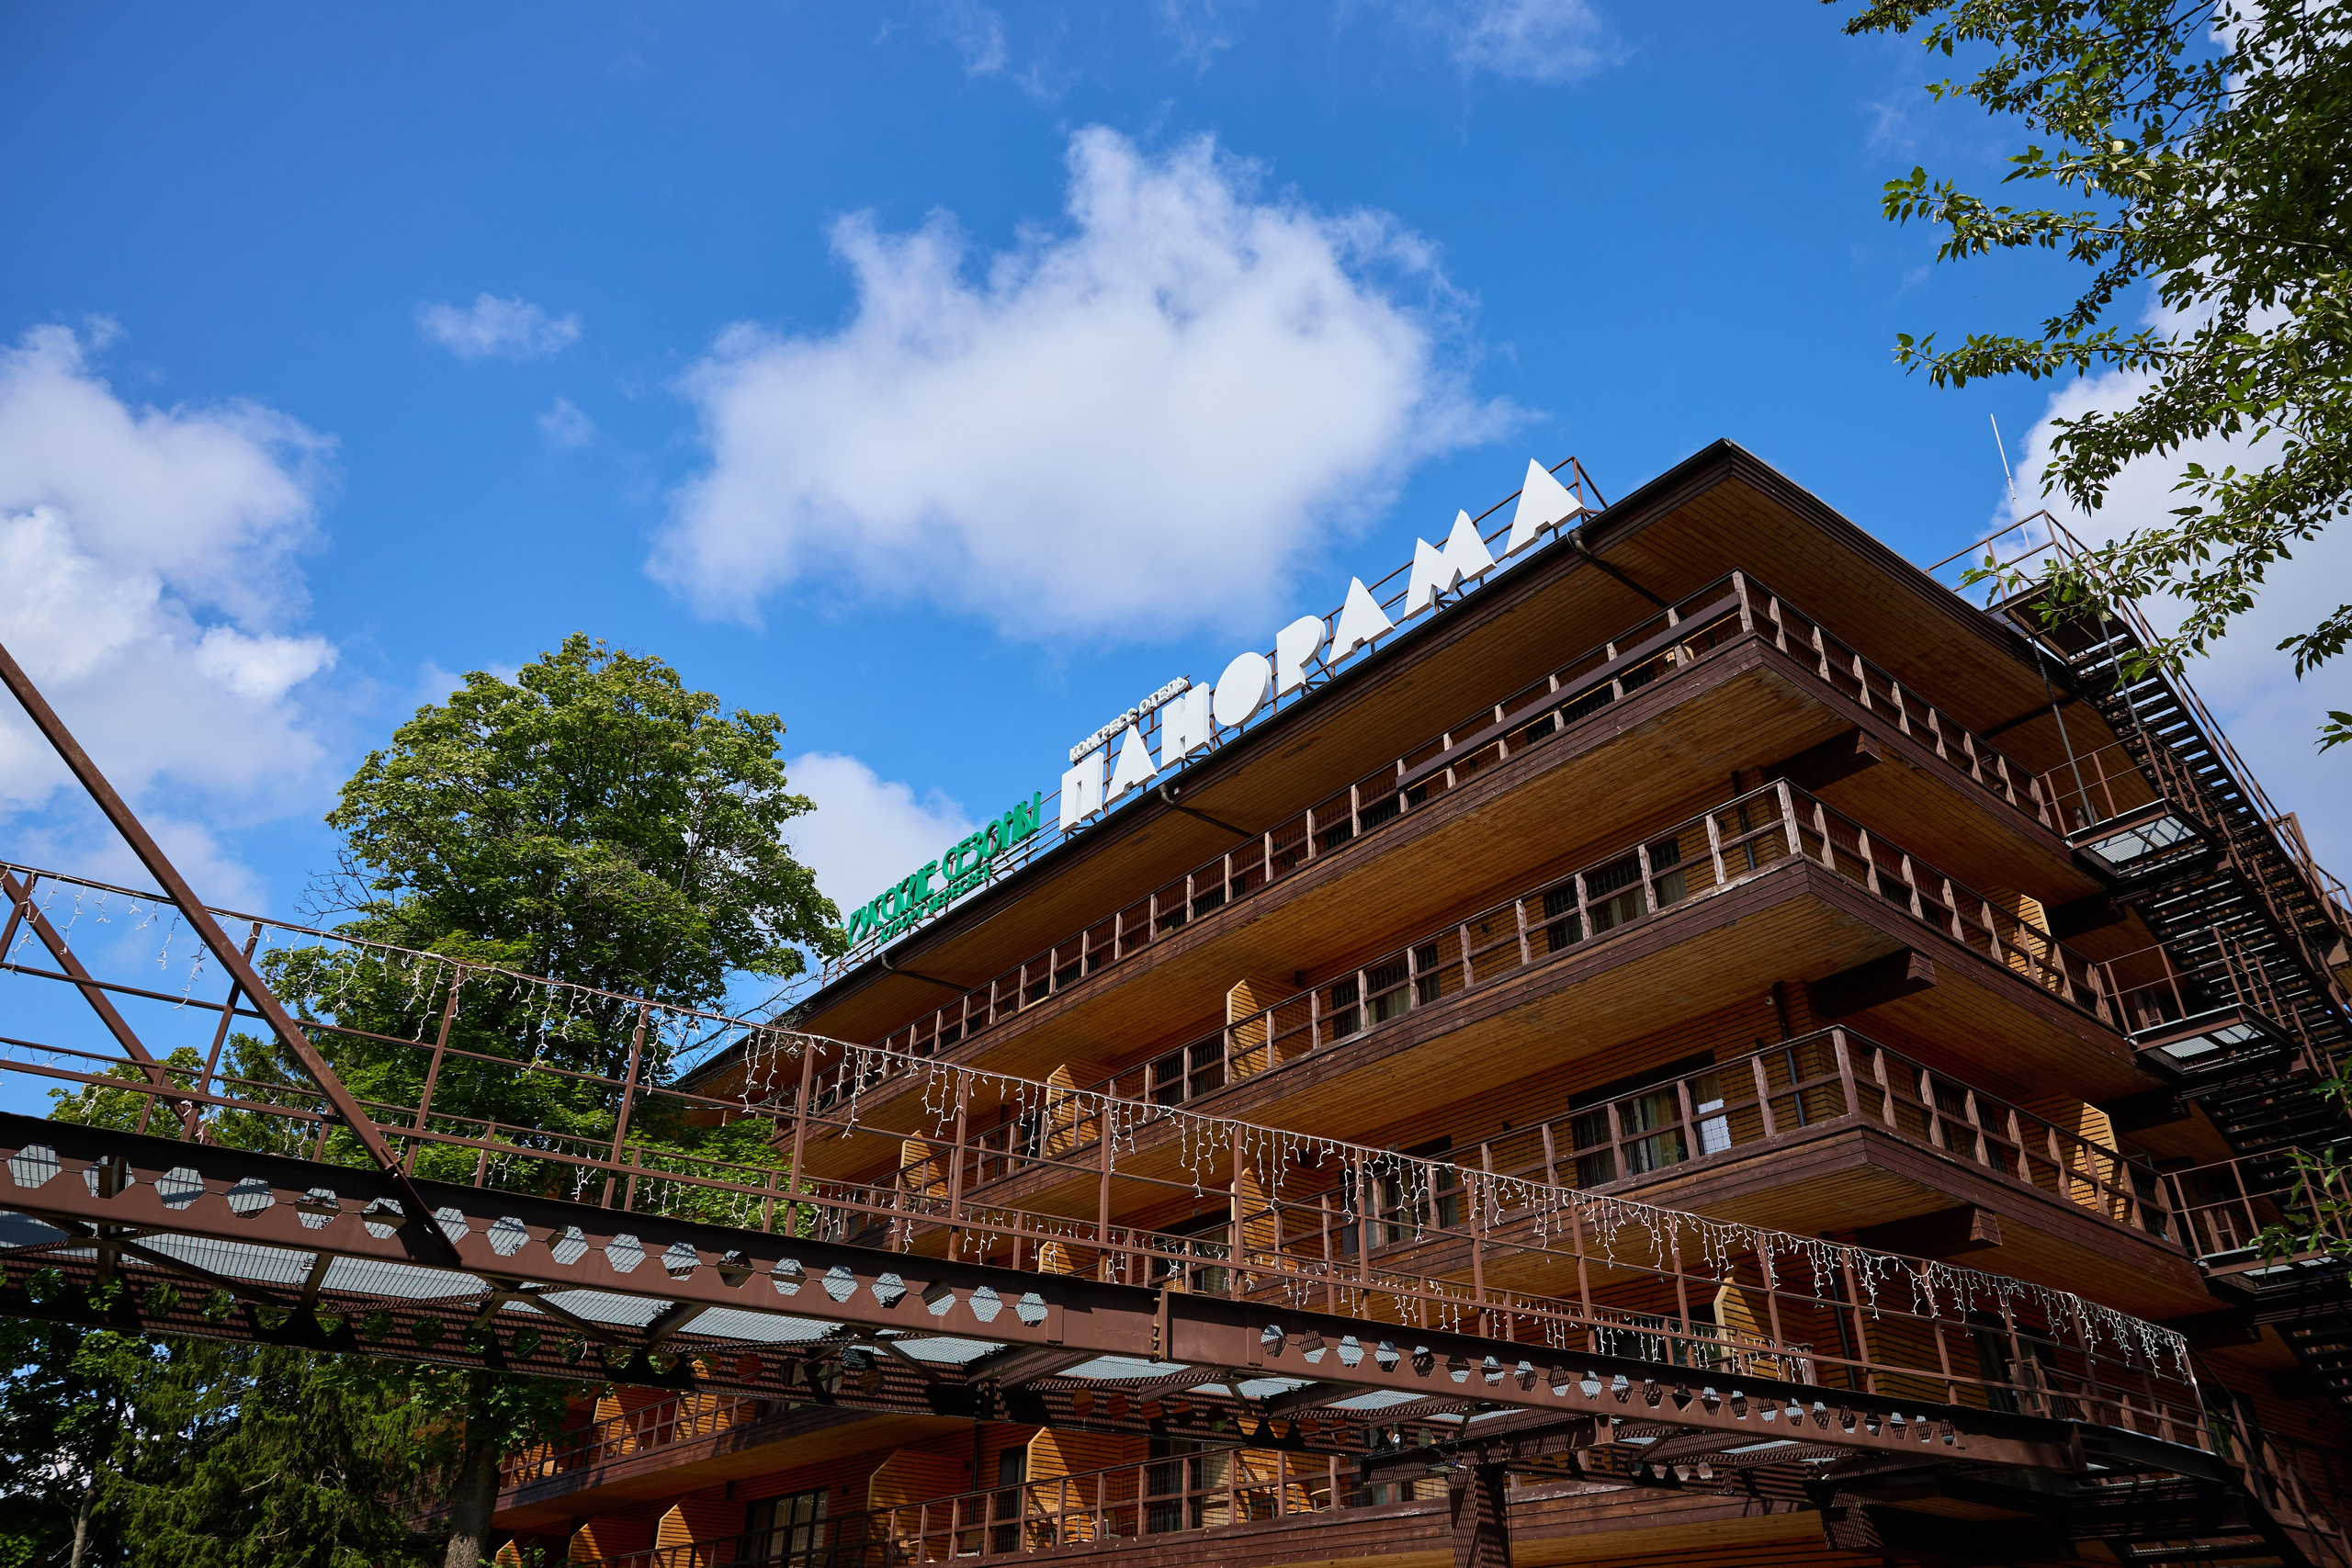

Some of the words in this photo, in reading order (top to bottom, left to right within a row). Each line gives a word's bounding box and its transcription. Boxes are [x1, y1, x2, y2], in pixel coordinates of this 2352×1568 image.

[1059, 457, 1585, 832] ПАНОРАМА
[1069, 707, 1139, 762] КОНГРЕСС
[1138, 676, 1189, 715] ОТЕЛЬ
[848, 859, 938, 947] РУССКИЕ
[942, 791, 1042, 882] СЕЗОНЫ
[879, 903, 927, 946] КУРОРТ
[927, 862, 994, 914] ПЕРЕСВЕТ
